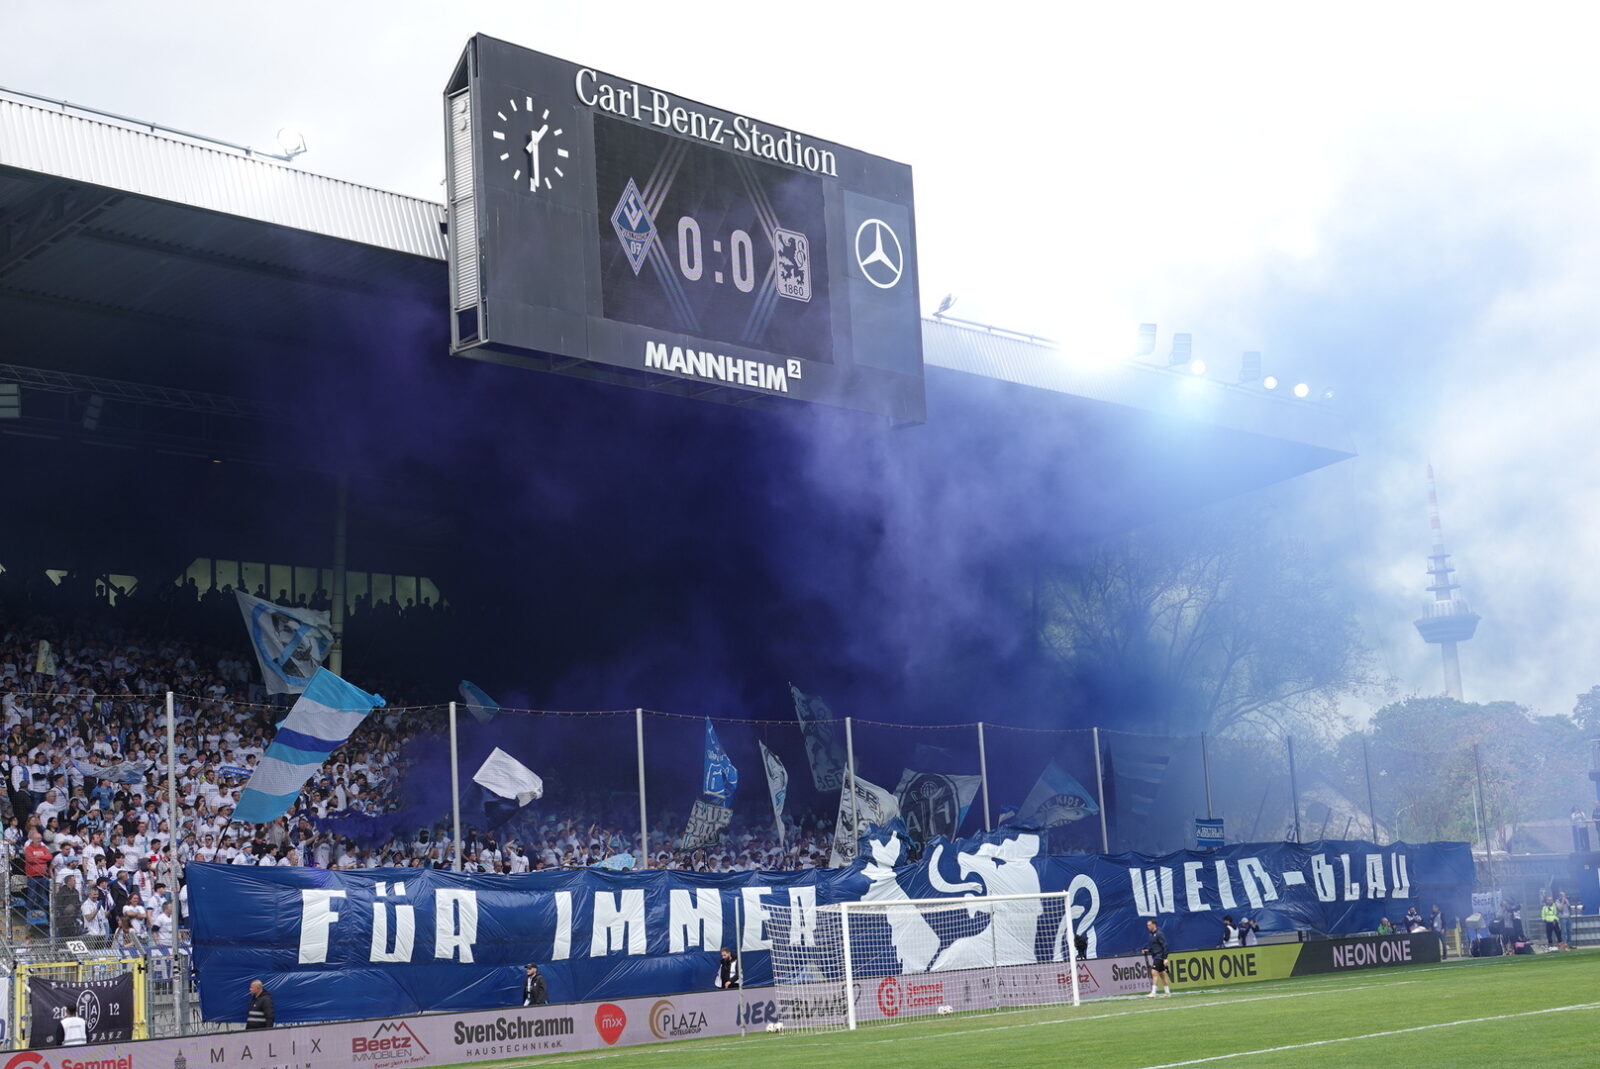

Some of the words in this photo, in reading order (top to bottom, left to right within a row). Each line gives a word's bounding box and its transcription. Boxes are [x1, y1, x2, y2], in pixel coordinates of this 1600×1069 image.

[575, 68, 838, 177] Carl-Benz-Stadion
[784, 283, 804, 297] 1860
[645, 341, 787, 392] MANNHEIM
[298, 881, 478, 965] FÜR
[551, 885, 817, 960] IMMER
[69, 942, 85, 953] 26
[1333, 943, 1377, 967] NEON
[1380, 940, 1412, 961] ONE
[1219, 953, 1256, 978] ONE
[1057, 973, 1090, 985] Betz
[109, 1003, 120, 1016] 12
[454, 1016, 574, 1045] SvenSchramm
[663, 1012, 708, 1031] PLAZA
[669, 1027, 702, 1037] HOTELGROUP
[210, 1038, 321, 1063] MALIX
[352, 1035, 411, 1053] Beetz
[466, 1041, 549, 1057] HAUSTECHNIK
[61, 1054, 133, 1069] Semmel
